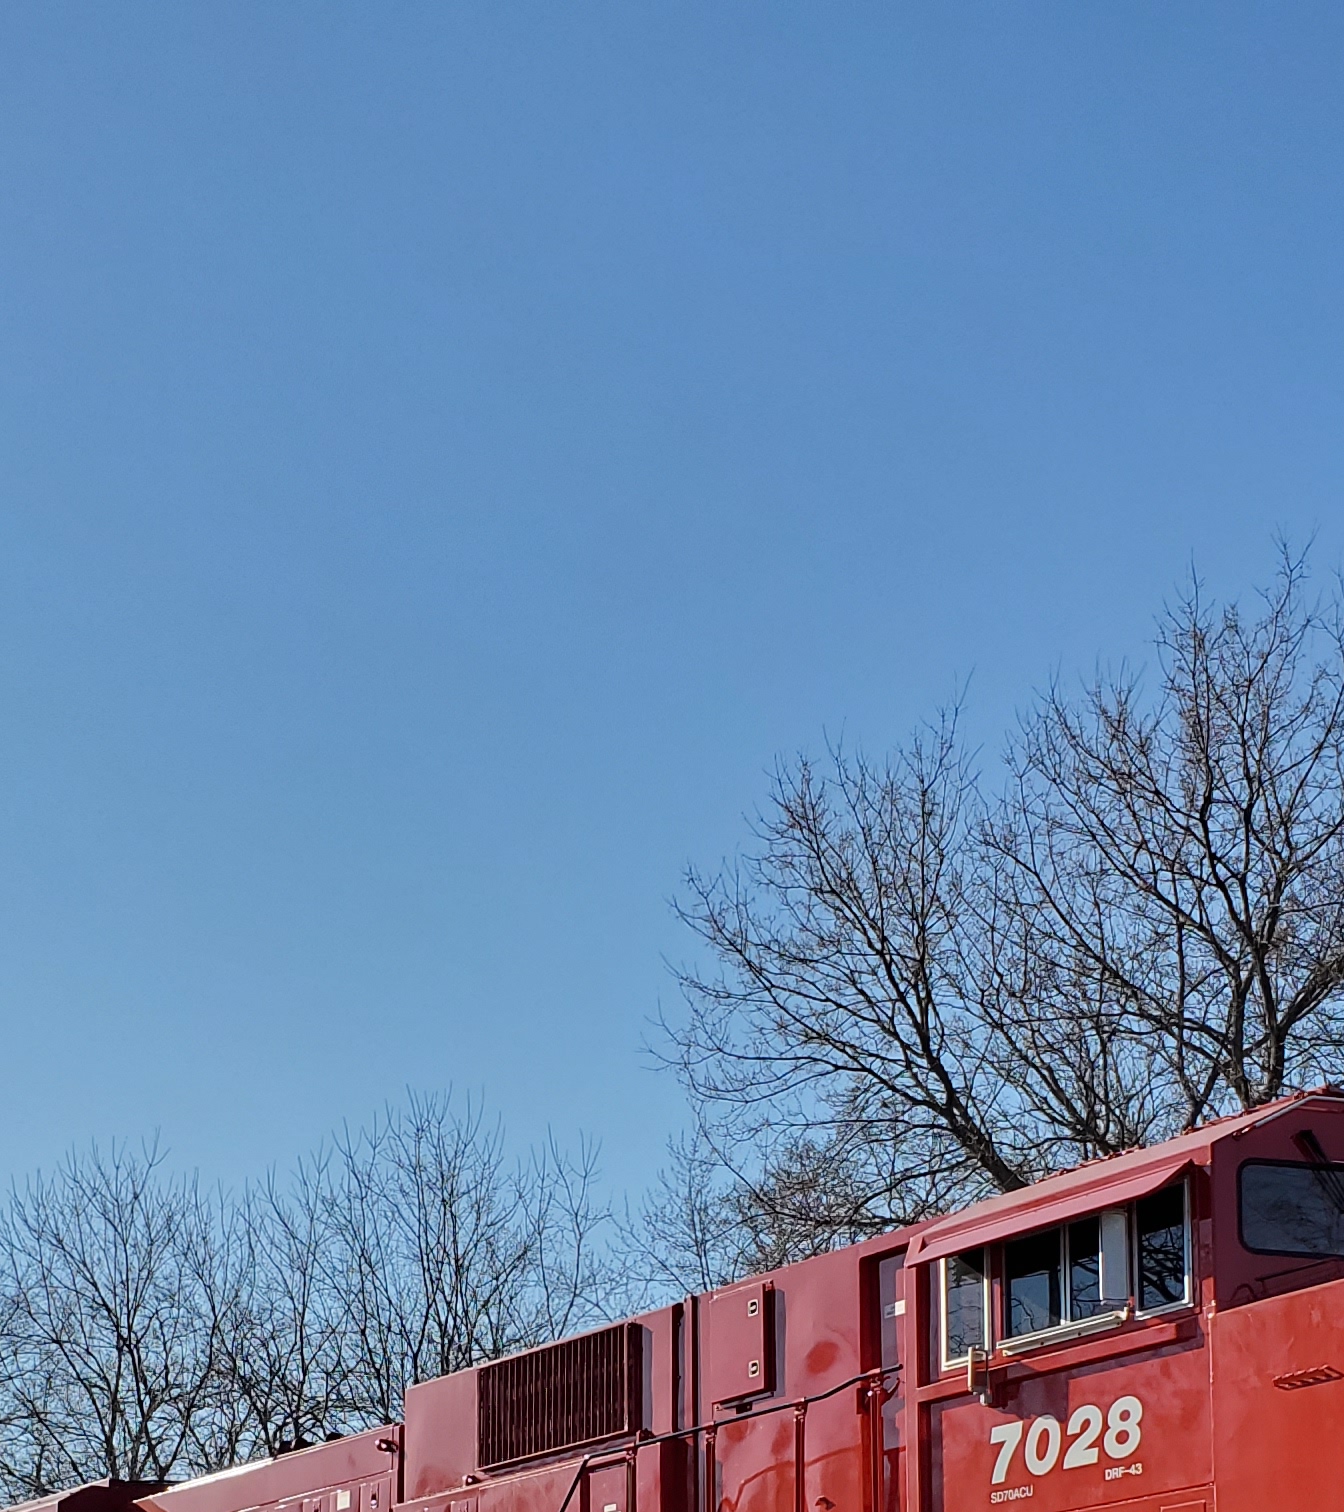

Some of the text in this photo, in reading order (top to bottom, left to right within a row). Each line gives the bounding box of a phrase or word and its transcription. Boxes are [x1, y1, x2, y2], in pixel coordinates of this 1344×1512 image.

[990, 1395, 1143, 1485] 7028
[1104, 1463, 1143, 1481] DRF-43
[990, 1484, 1034, 1504] SD70ACU
